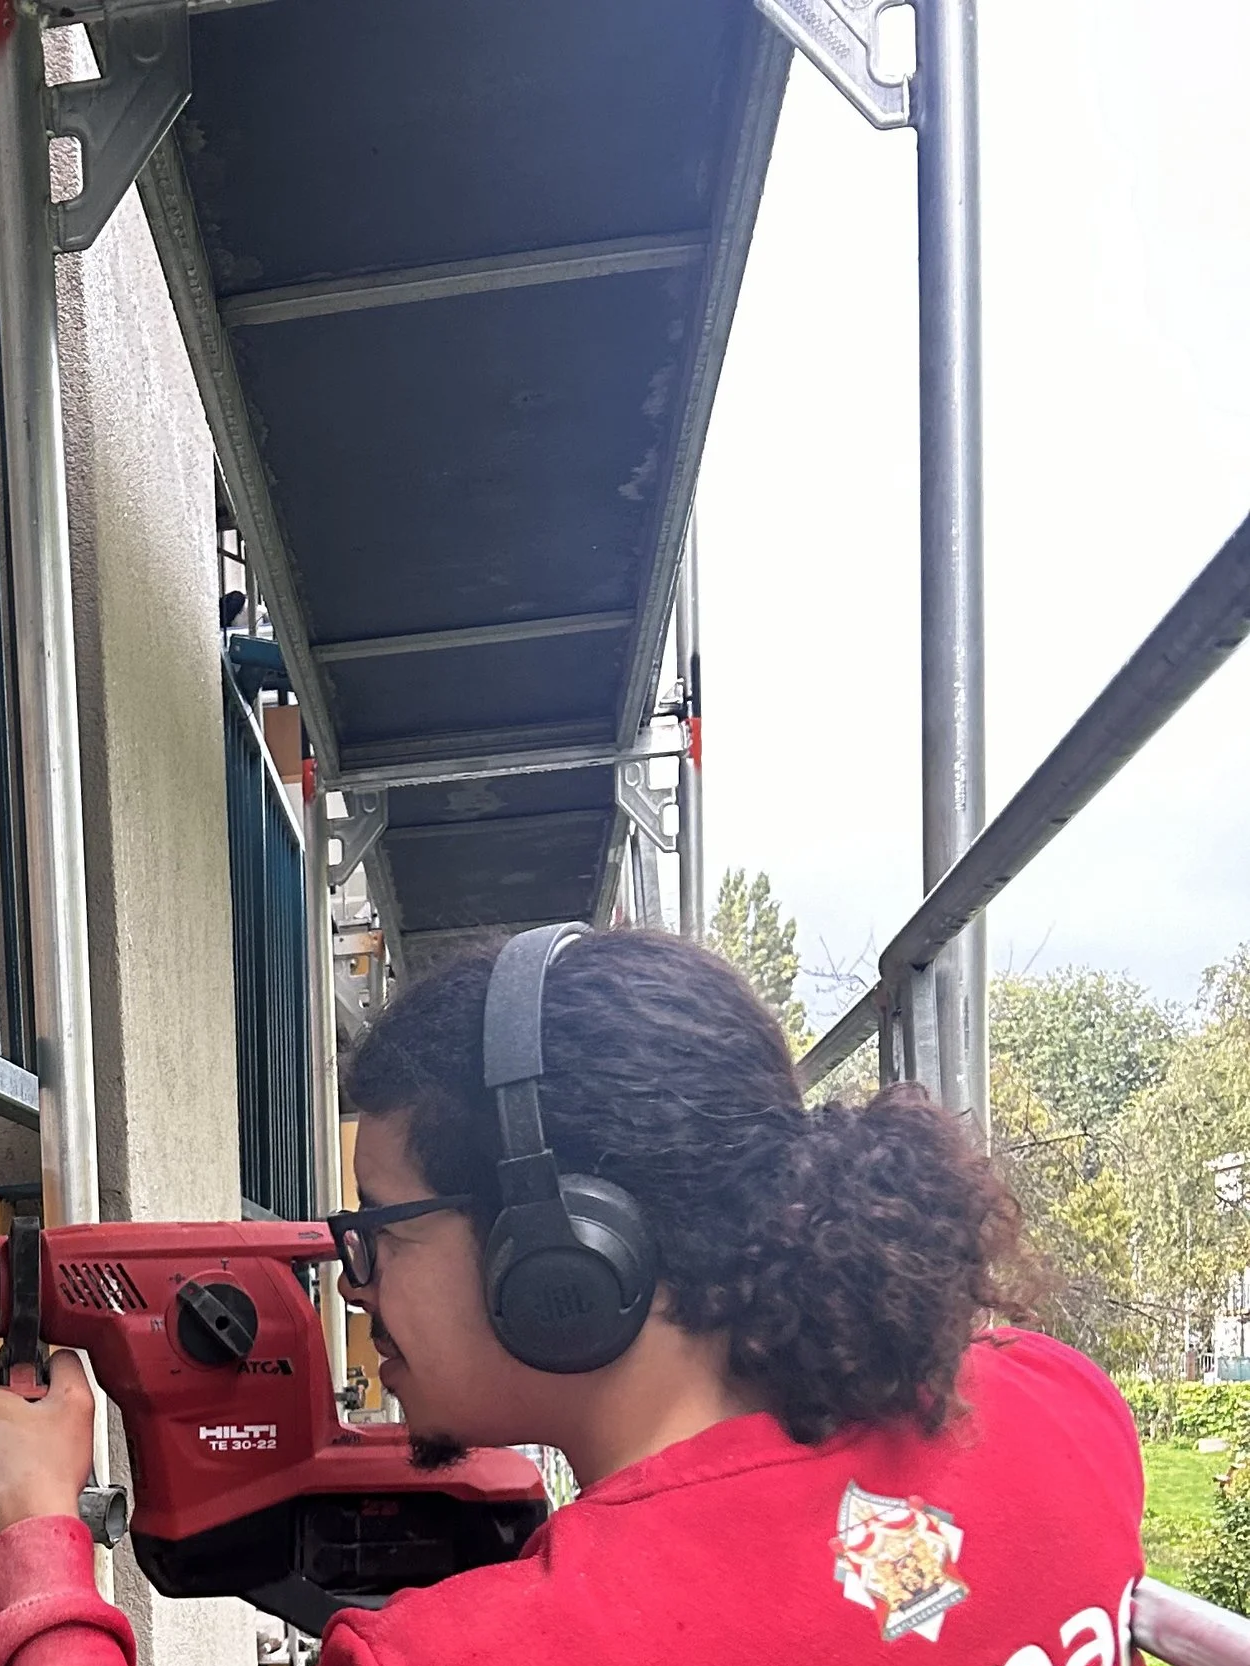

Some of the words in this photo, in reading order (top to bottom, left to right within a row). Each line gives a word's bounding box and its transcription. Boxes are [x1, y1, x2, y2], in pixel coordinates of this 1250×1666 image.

[199, 1424, 277, 1440] HILTI
[209, 1440, 228, 1451] TE
[232, 1439, 277, 1450] 30-22
